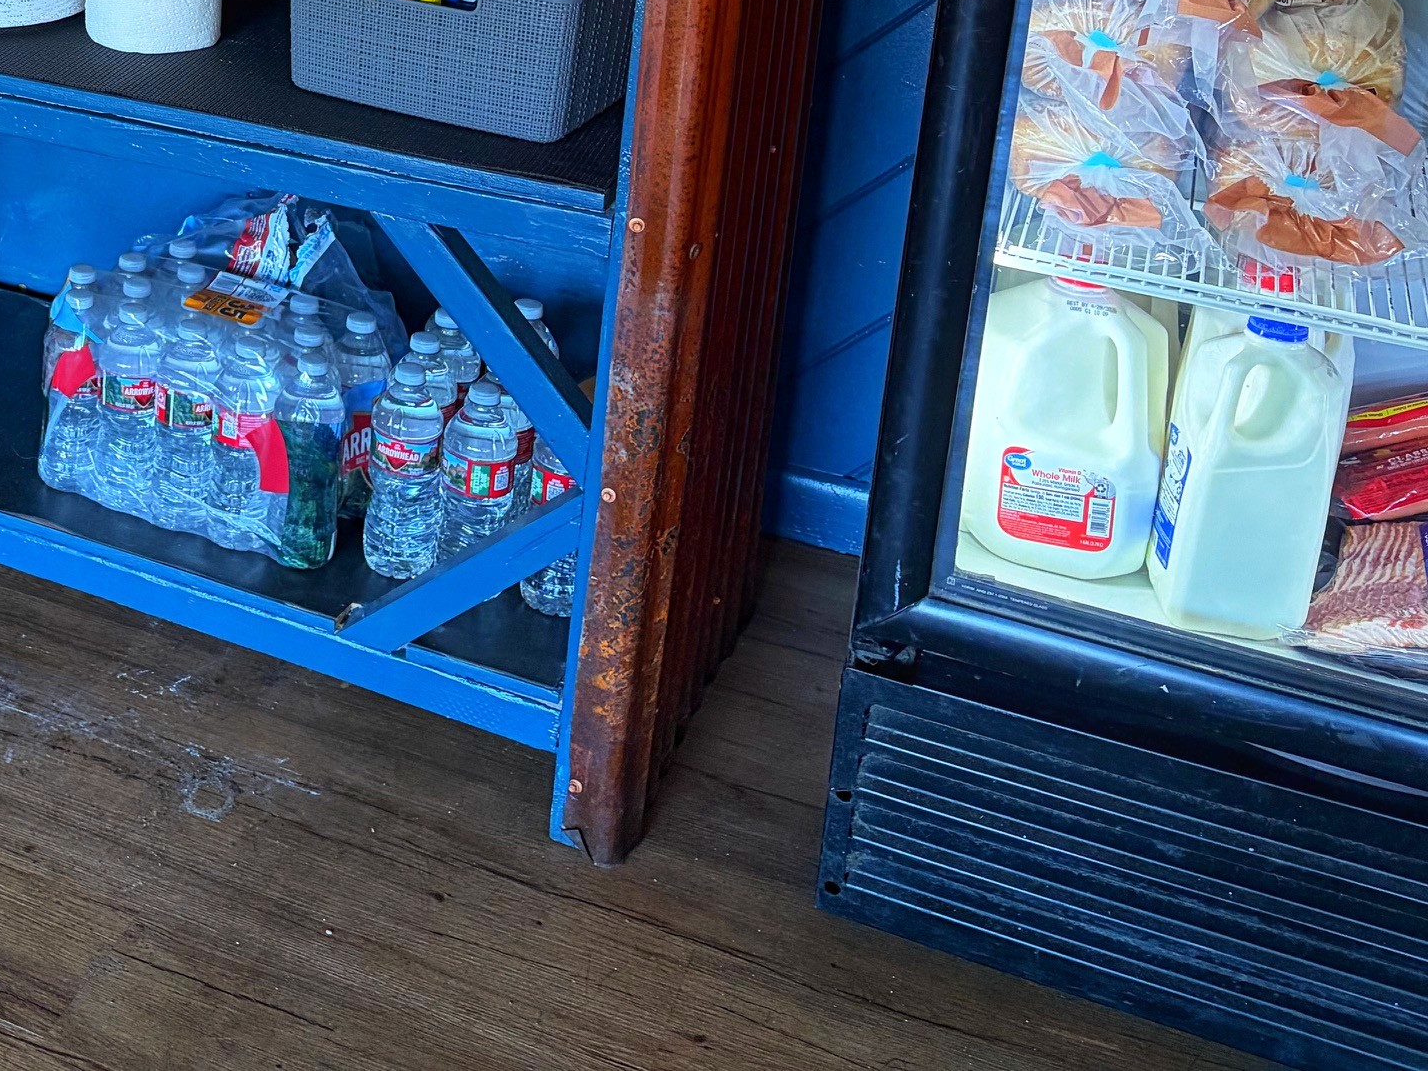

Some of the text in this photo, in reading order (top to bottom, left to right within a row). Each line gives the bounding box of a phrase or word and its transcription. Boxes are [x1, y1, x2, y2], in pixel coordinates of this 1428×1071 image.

[377, 443, 420, 462] ARROWHEAD
[1032, 469, 1081, 484] Whole Milk
[1058, 467, 1075, 475] Vitamin
